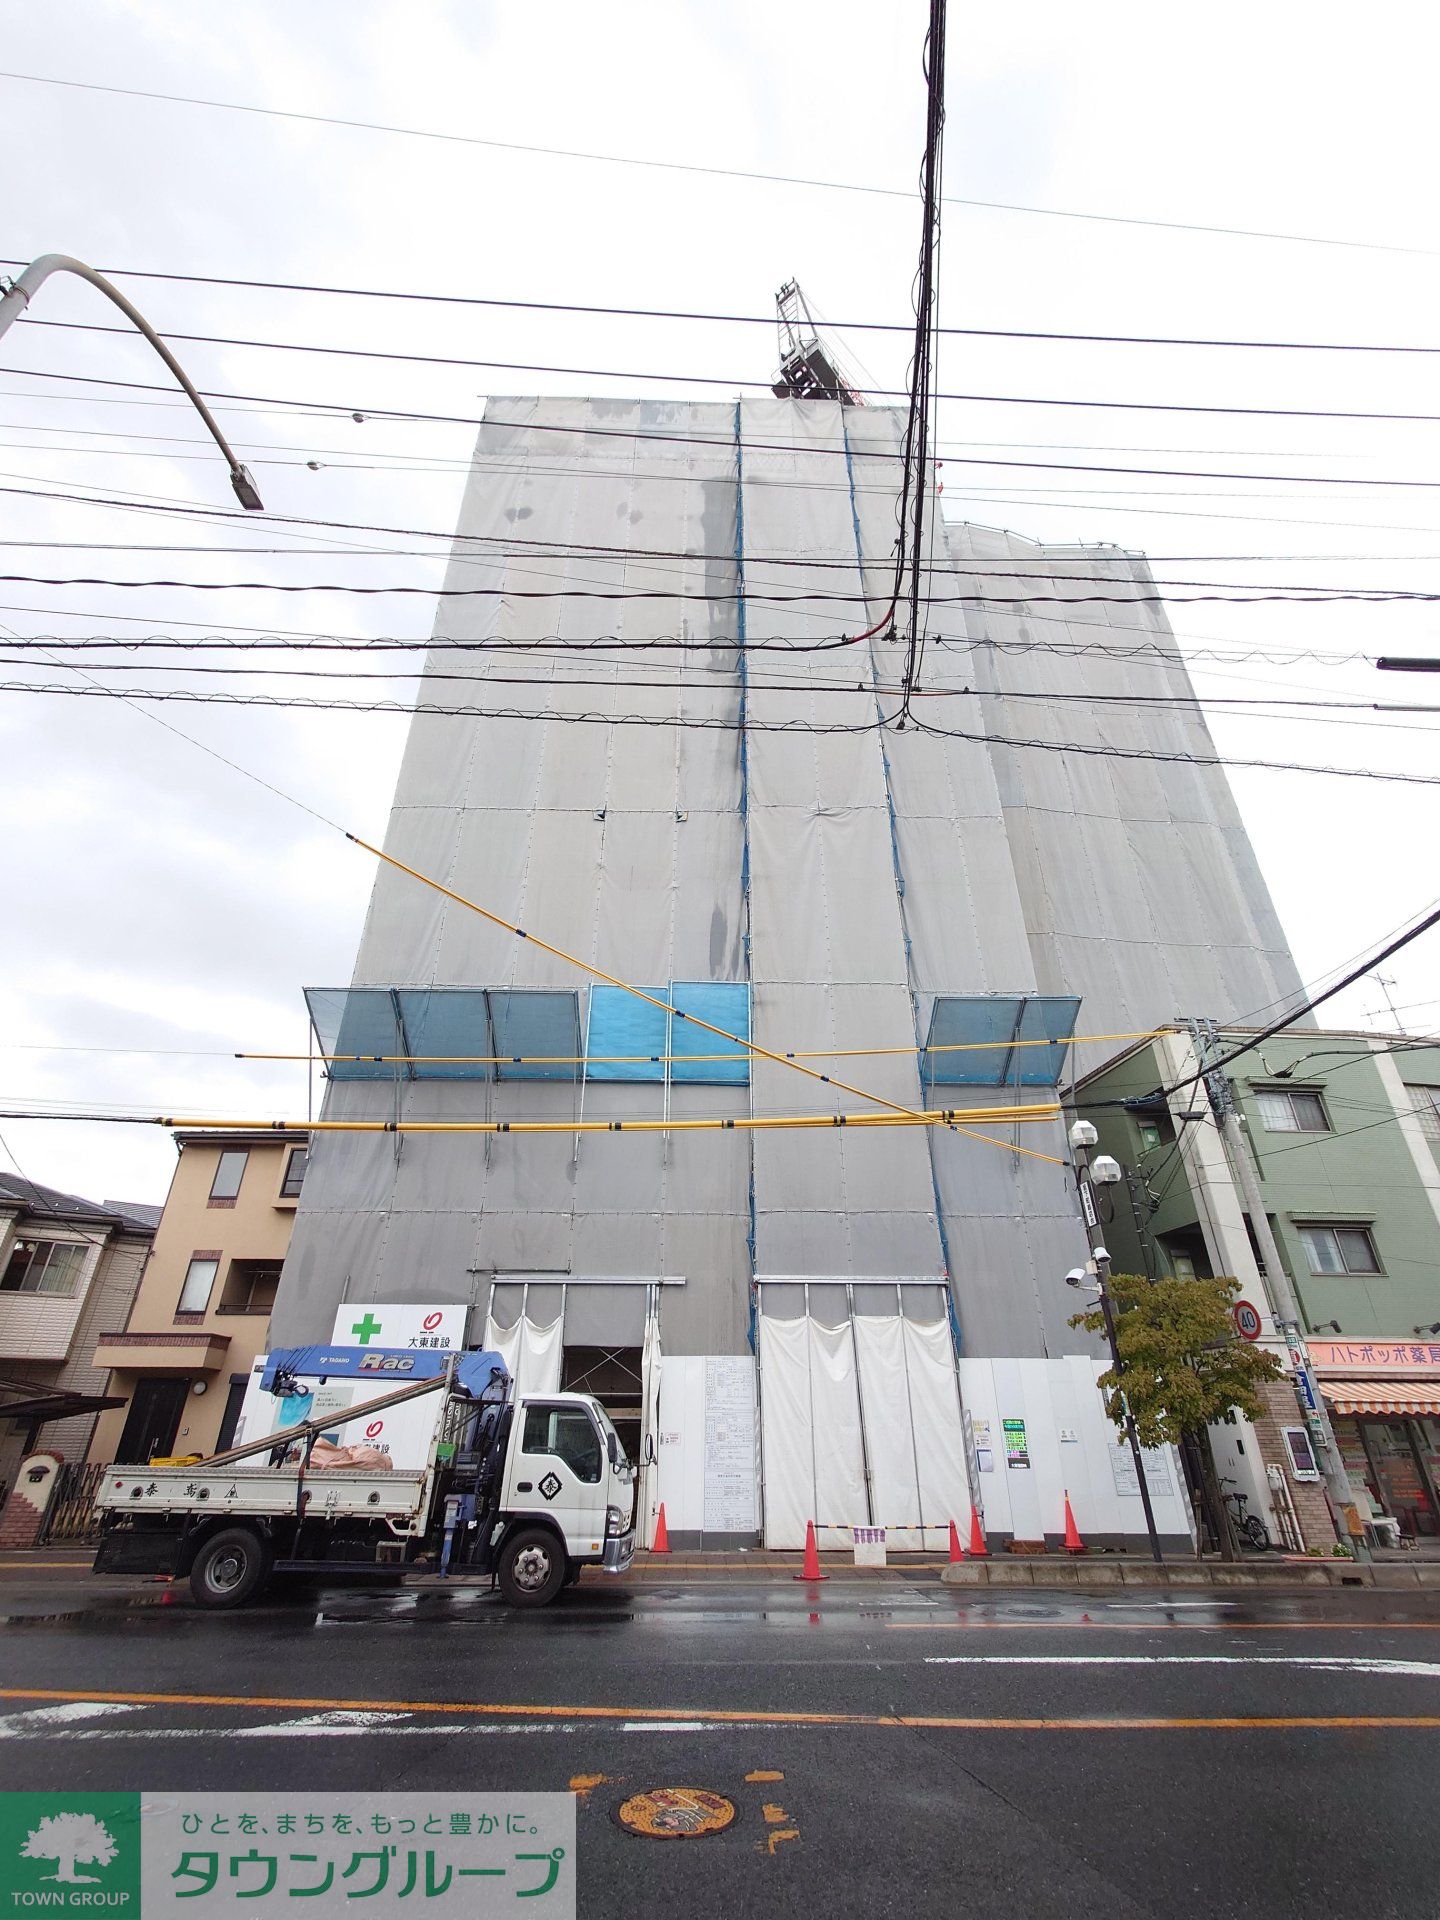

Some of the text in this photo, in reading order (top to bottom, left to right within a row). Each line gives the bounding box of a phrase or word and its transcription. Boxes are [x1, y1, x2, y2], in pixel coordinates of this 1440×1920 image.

[1241, 1311, 1256, 1329] 40
[408, 1336, 451, 1348] 大東建設
[358, 1353, 415, 1371] Rac
[1331, 1345, 1440, 1364] ハトポッポ薬局
